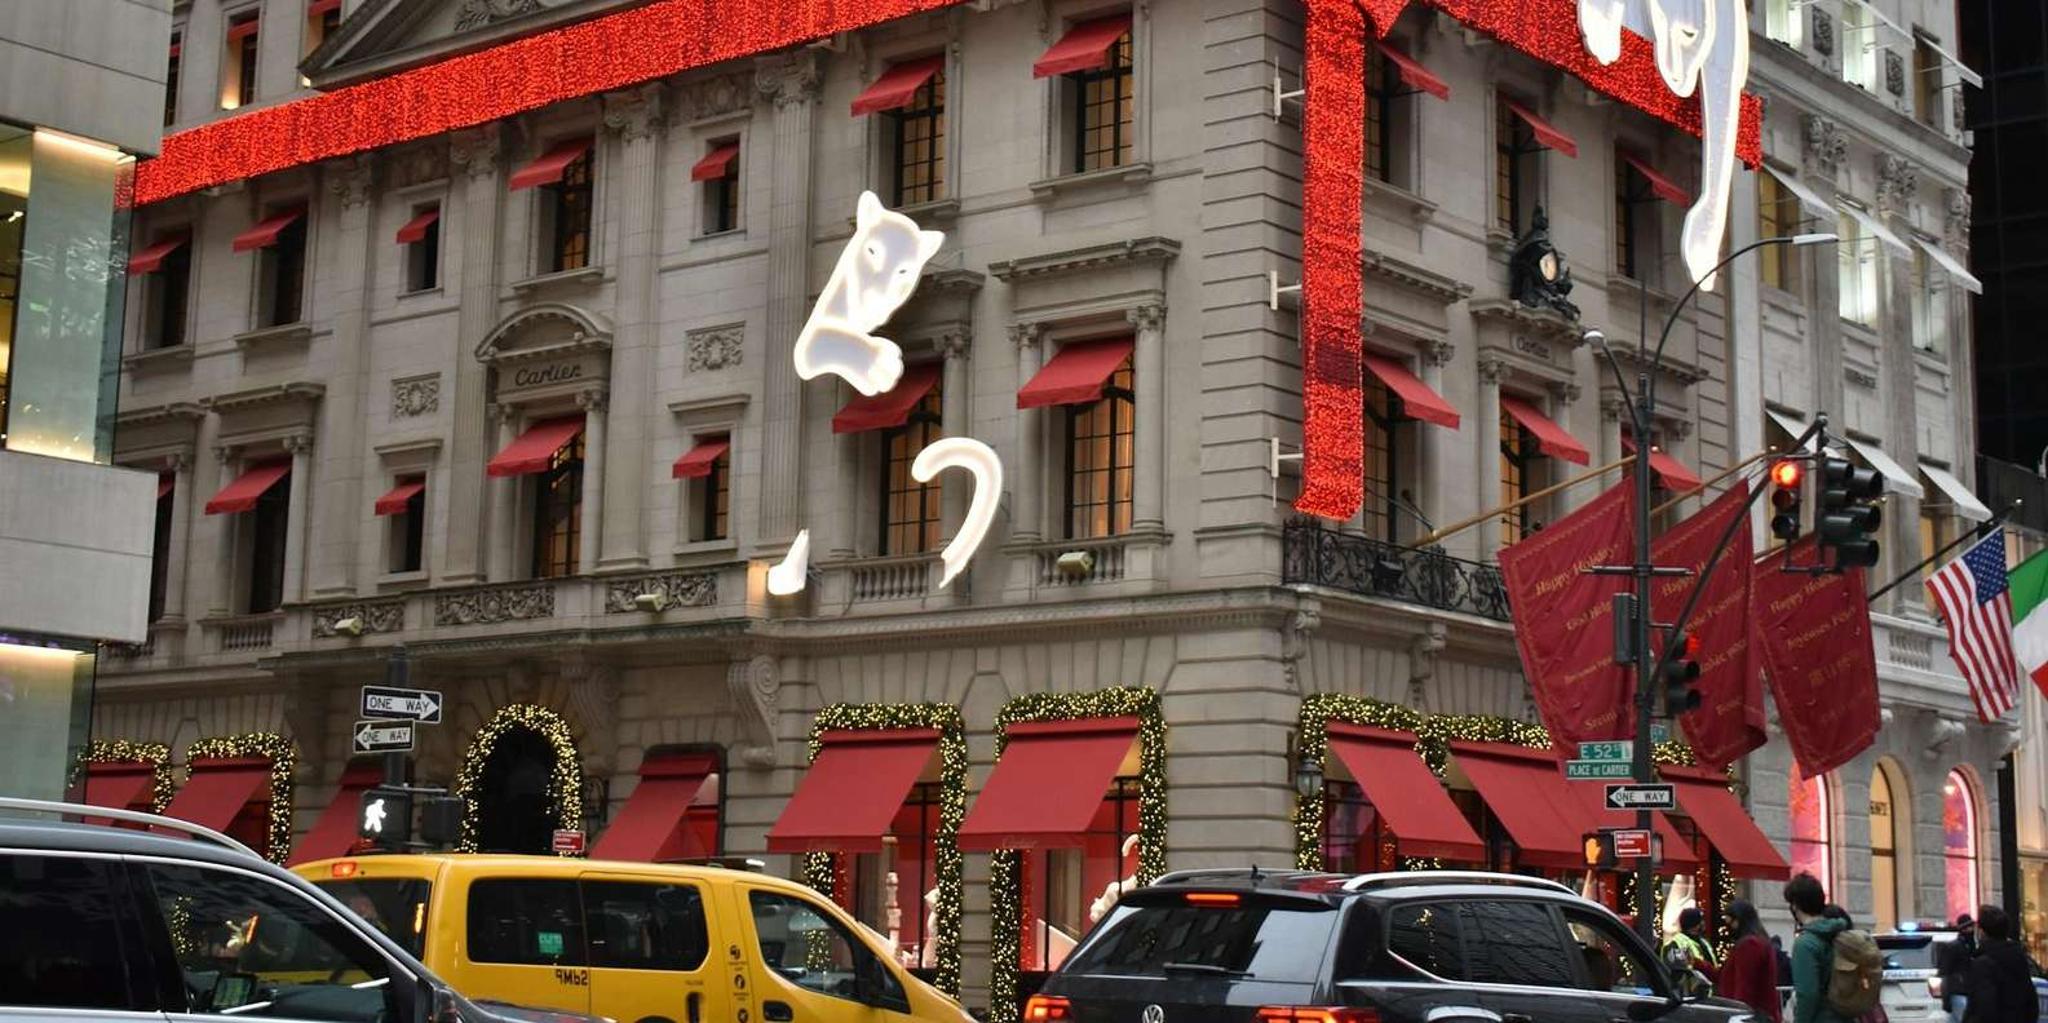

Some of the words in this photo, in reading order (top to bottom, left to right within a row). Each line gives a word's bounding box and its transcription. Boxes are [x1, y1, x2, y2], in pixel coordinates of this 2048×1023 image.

[514, 364, 582, 386] Cartier
[1535, 570, 1571, 596] Happy
[1769, 592, 1805, 614] Happy
[369, 696, 393, 710] ONE
[405, 700, 430, 712] WAY
[362, 731, 381, 743] ONE
[389, 731, 408, 741] WAY
[1581, 745, 1589, 758] E
[1594, 744, 1612, 758] 52
[1568, 765, 1590, 776] PLACE
[1602, 765, 1630, 775] CARTIER
[1615, 792, 1634, 801] ONE
[1644, 792, 1665, 801] WAY
